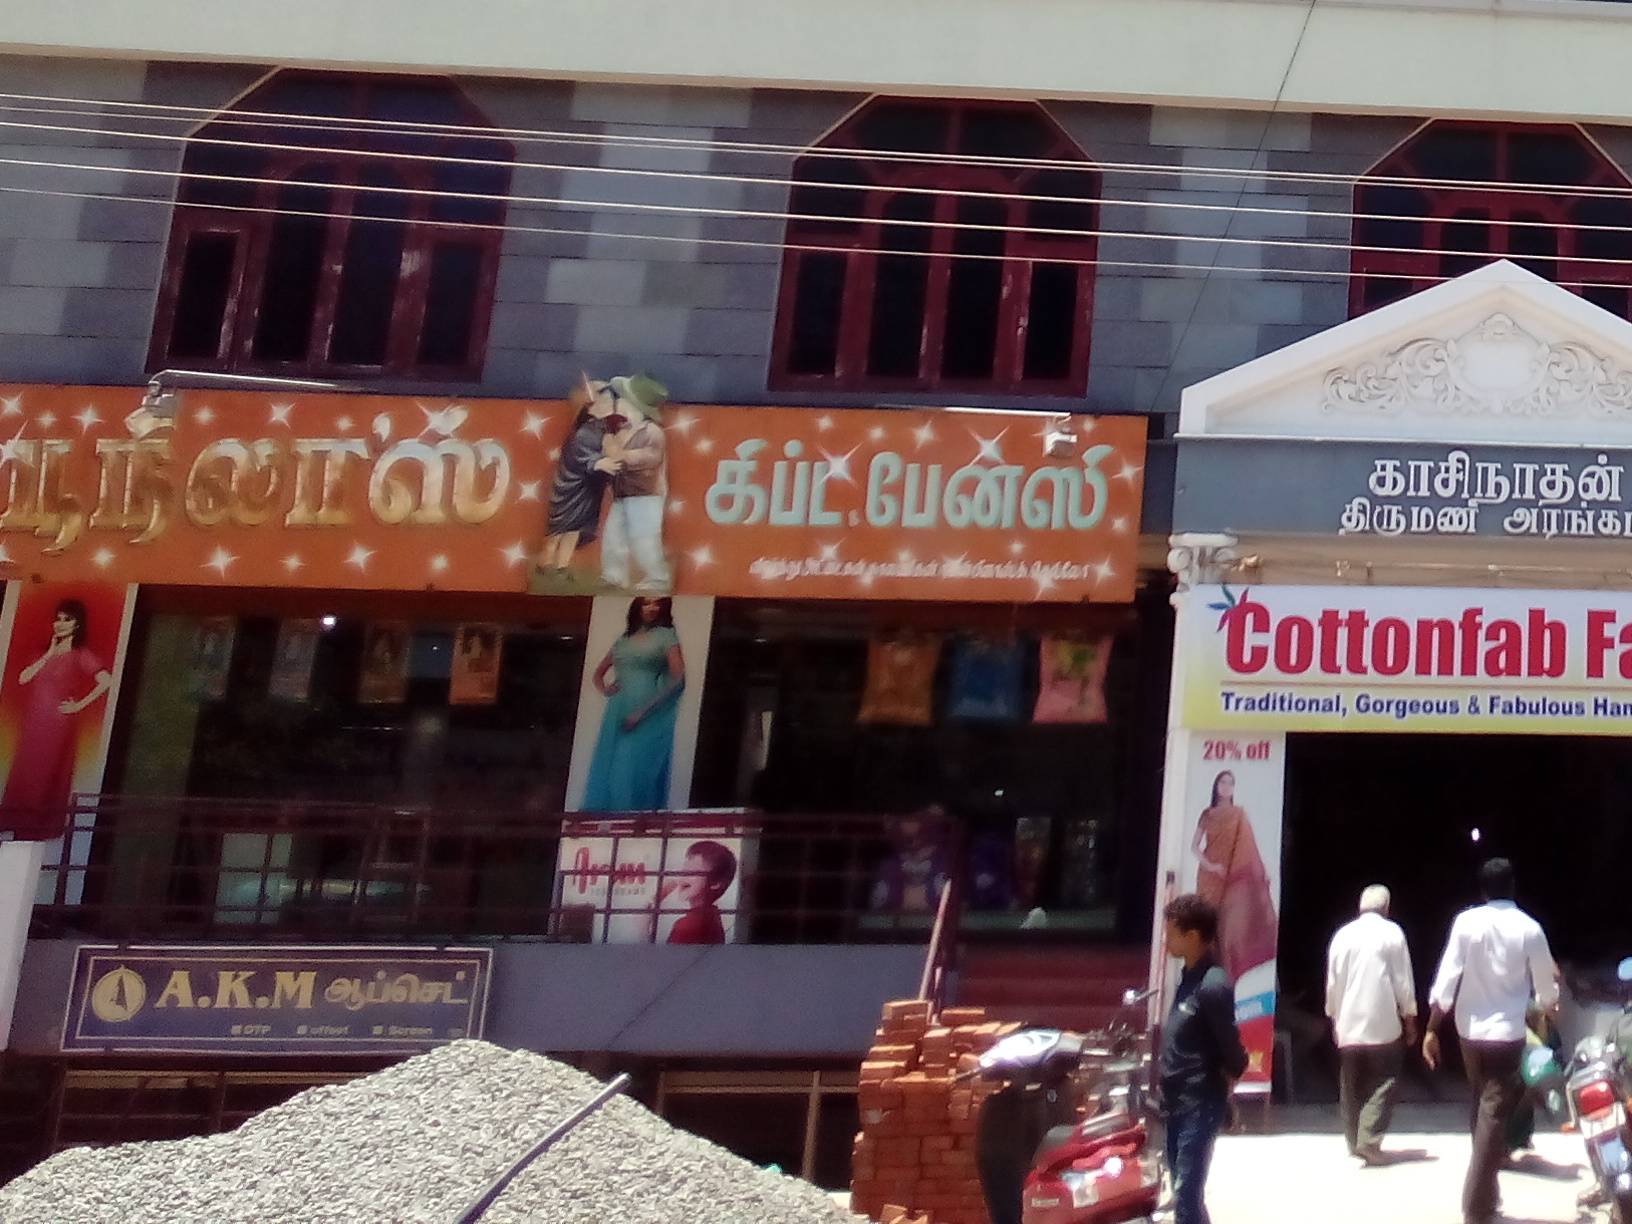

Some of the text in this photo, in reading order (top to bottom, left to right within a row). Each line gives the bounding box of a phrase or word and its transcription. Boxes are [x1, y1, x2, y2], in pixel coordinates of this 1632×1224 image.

[1368, 449, 1625, 507] காசிநாதன்
[1225, 599, 1567, 679] Cottonfab
[1221, 693, 1348, 718] Traditional,
[1355, 694, 1460, 720] Gorgeous
[1468, 695, 1481, 715] &
[1489, 696, 1586, 717] Fabulous
[1203, 740, 1270, 761] 20% off
